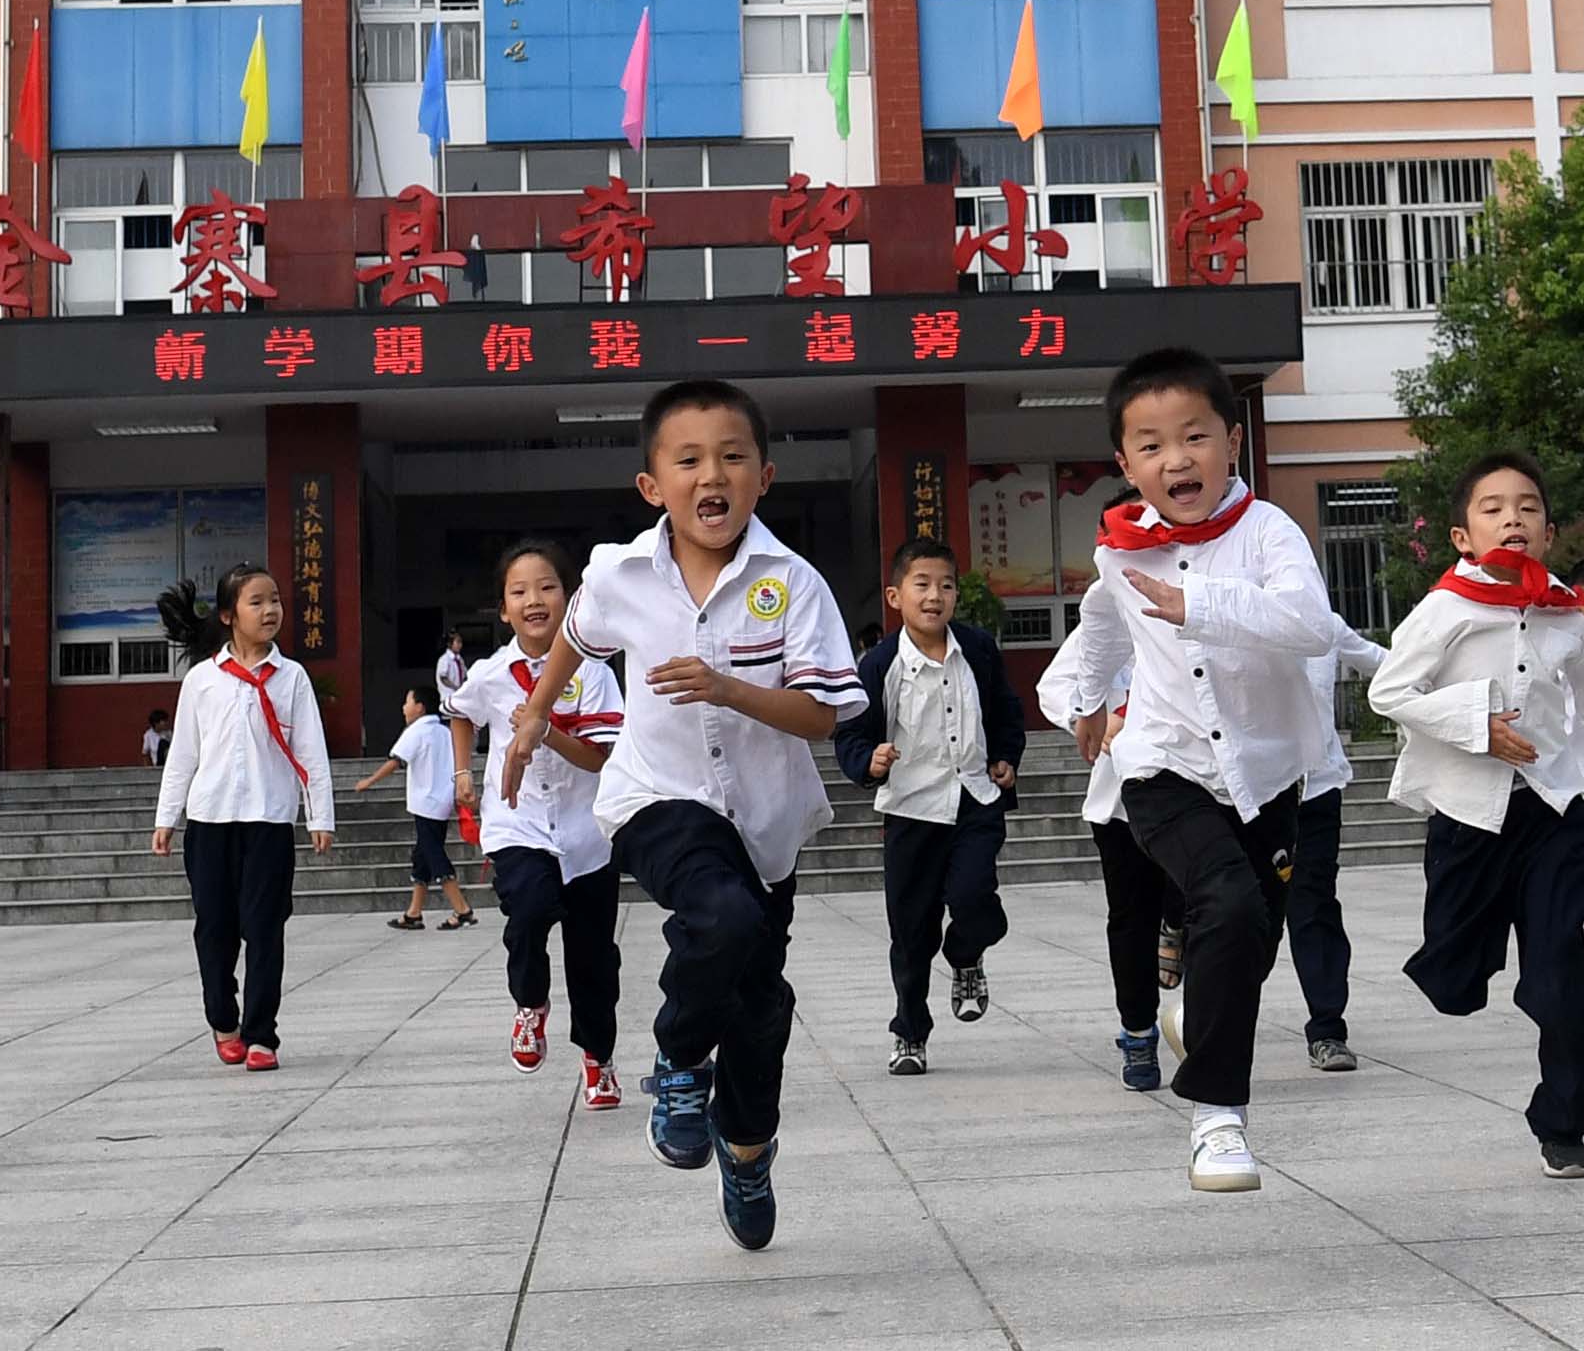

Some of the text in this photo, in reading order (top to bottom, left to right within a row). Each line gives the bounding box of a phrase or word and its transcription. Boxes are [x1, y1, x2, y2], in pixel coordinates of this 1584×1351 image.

[153, 308, 1066, 381] 新学期你我一起努力
